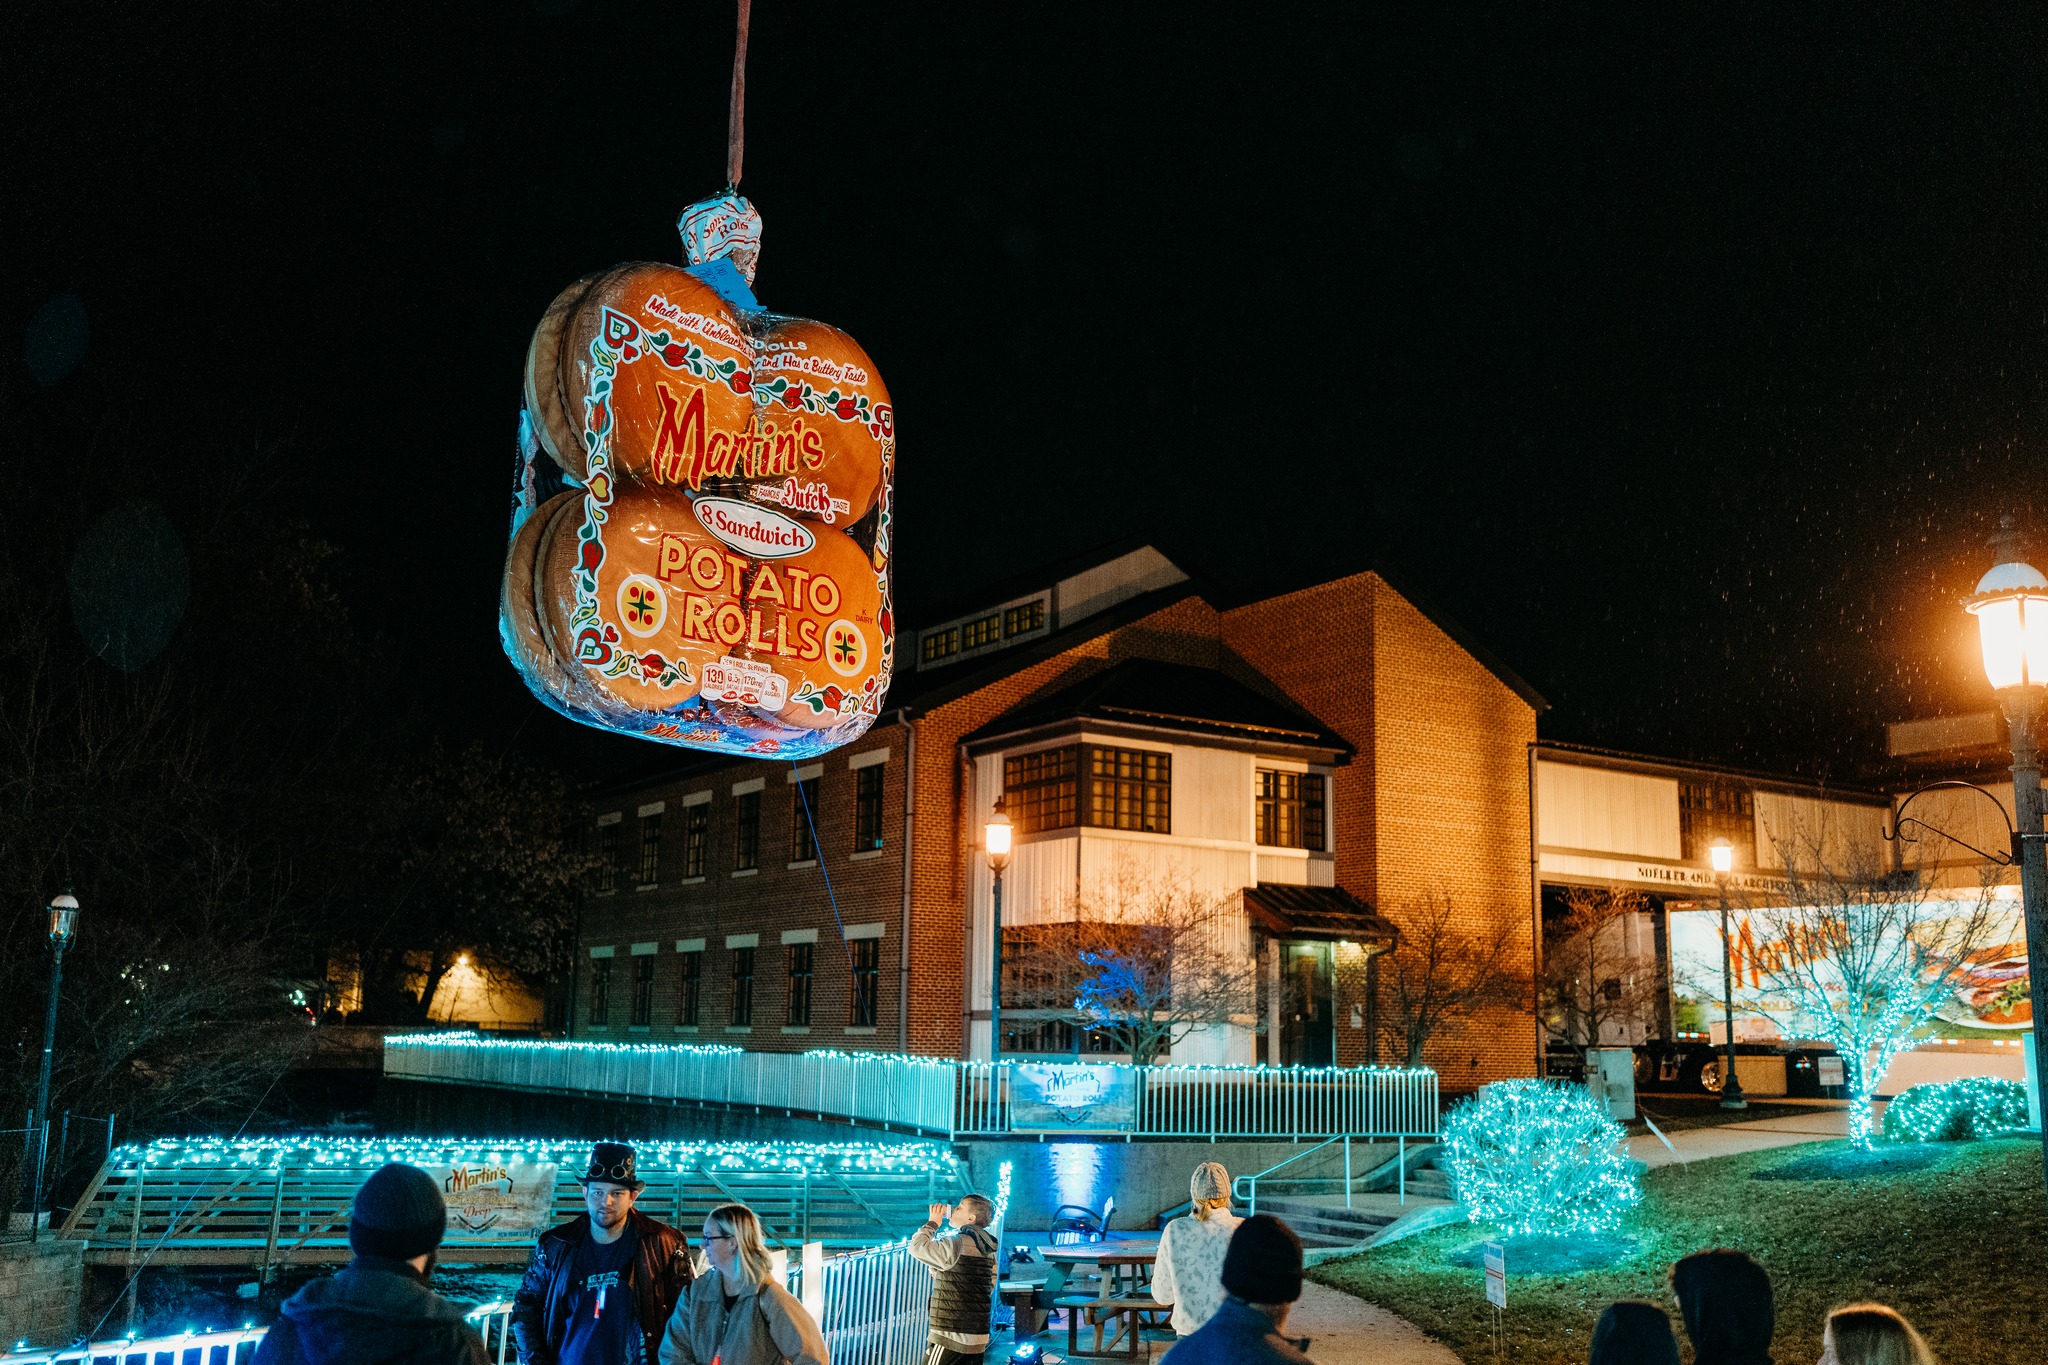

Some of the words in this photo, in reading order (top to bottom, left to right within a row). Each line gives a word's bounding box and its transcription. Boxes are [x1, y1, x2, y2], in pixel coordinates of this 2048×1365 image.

[648, 298, 678, 320] Made
[677, 315, 700, 331] with
[762, 358, 779, 368] and
[783, 356, 800, 367] Has
[812, 360, 842, 381] Buttery
[844, 367, 865, 383] Taste
[651, 381, 825, 491] Martin's
[758, 487, 780, 500] FAMOUS
[781, 478, 833, 521] Dutch
[832, 500, 849, 515] TASTE
[702, 504, 713, 525] 8
[715, 510, 805, 547] Sandwich
[658, 533, 840, 617] POTATO
[682, 592, 823, 662] ROLLS
[856, 615, 873, 625] DAIRY
[706, 668, 724, 684] 130
[1051, 1070, 1094, 1091] Martin's
[452, 1166, 506, 1193] Martin's
[463, 1205, 492, 1219] Drop
[489, 1195, 516, 1206] ROLL
